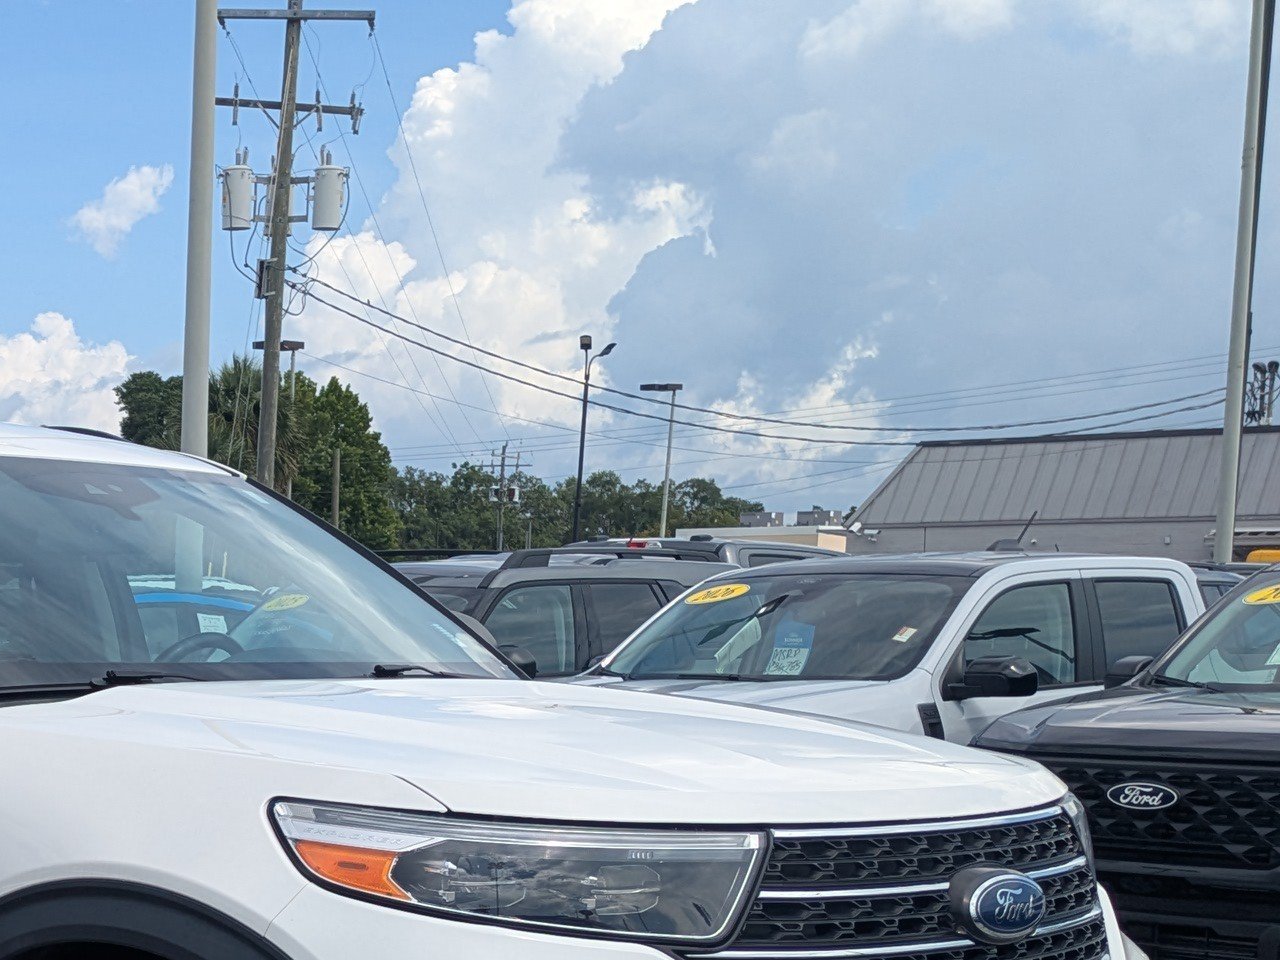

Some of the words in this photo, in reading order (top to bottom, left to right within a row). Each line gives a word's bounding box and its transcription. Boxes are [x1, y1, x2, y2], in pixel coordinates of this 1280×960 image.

[1119, 785, 1163, 806] Ford
[304, 827, 405, 845] EXPLORER
[994, 887, 1035, 923] Ford
